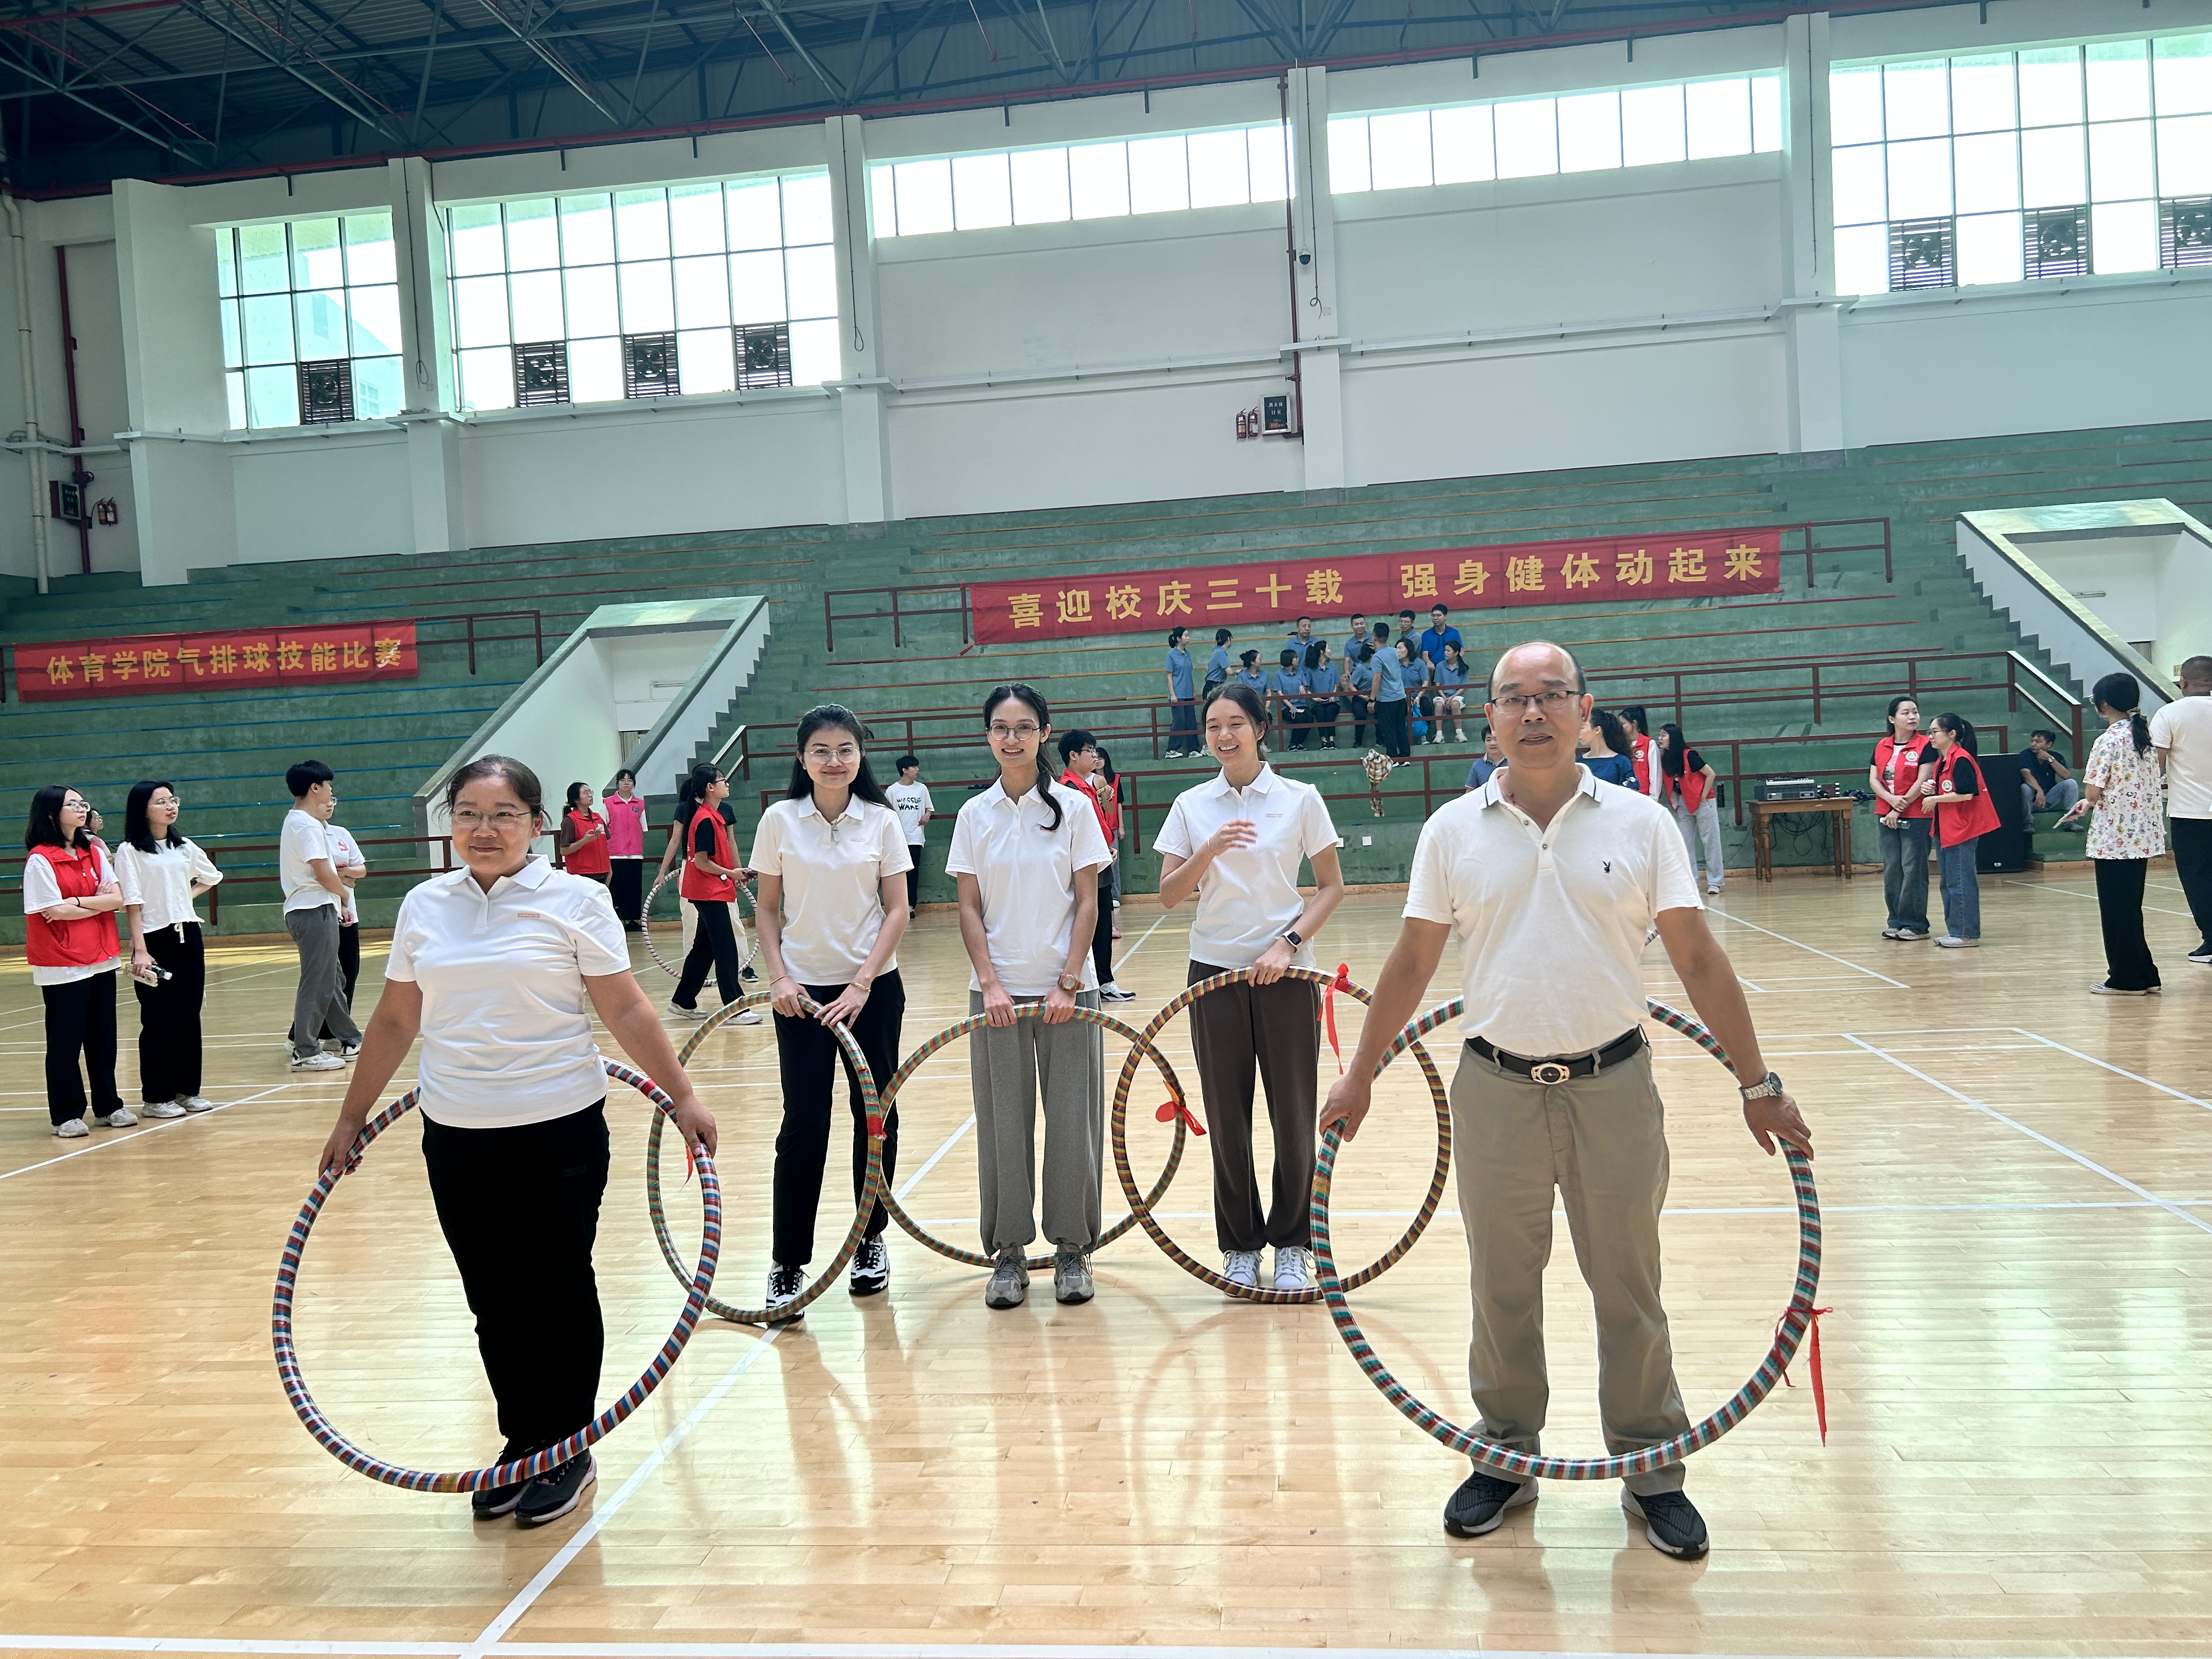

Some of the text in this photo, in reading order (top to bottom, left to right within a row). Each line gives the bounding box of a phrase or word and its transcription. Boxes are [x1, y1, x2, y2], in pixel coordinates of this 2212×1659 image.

[1008, 544, 1762, 629] 喜迎校庆三十载 强身健体动起来
[47, 638, 402, 685] 体育学院气排球技能比赛
